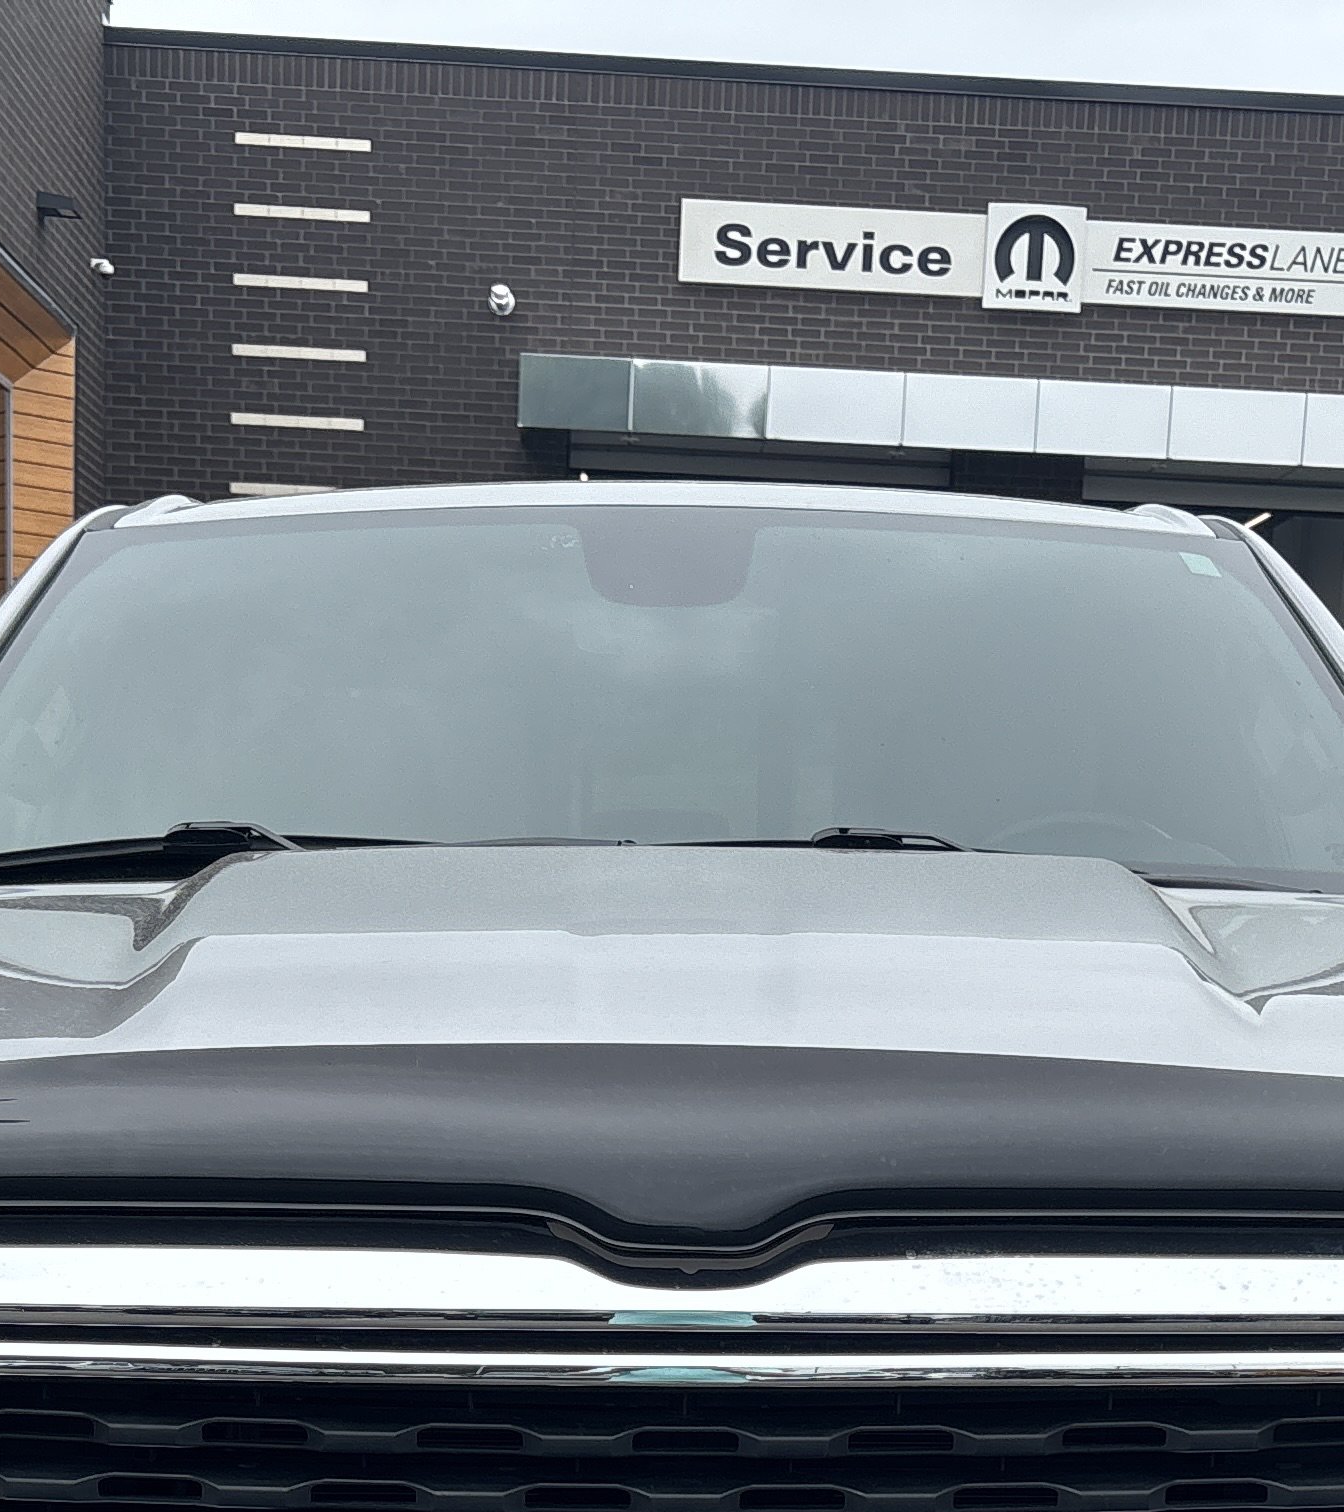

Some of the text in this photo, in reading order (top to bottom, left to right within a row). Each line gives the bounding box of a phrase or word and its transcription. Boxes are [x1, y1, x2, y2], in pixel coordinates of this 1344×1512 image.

[714, 223, 952, 277] Service
[995, 288, 1069, 302] MOPAR
[1105, 278, 1316, 305] FAST OIL CHANGES & MORE
